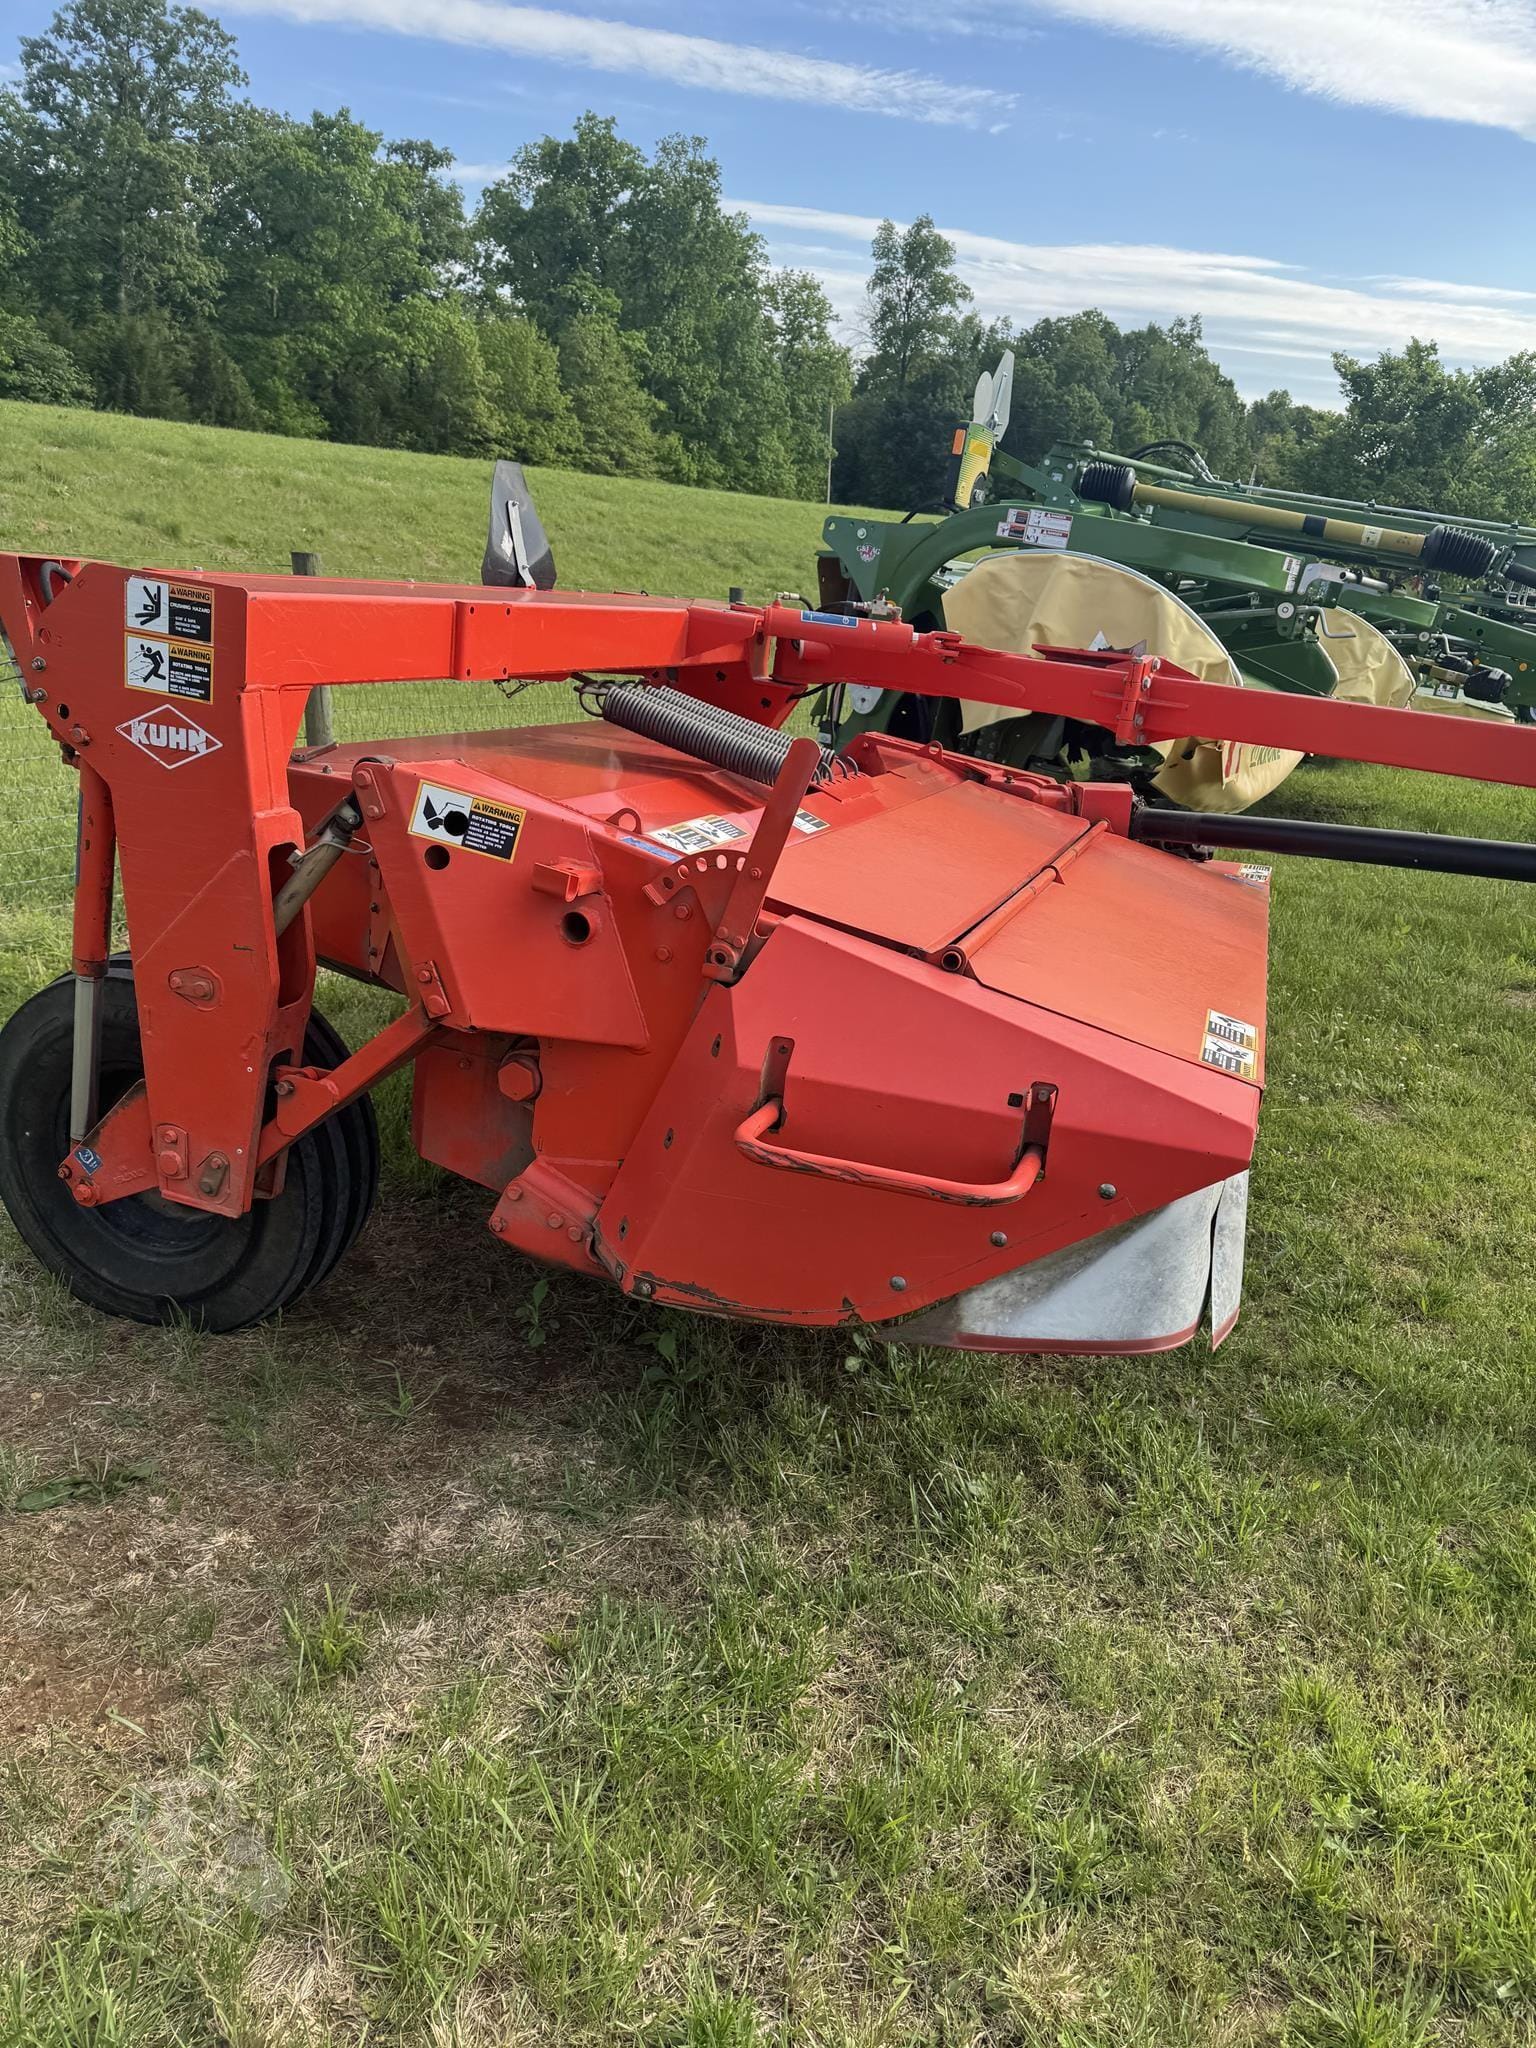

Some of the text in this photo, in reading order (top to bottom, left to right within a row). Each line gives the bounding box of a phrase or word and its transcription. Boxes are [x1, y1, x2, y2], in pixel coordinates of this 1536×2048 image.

[176, 588, 210, 601] WARNING
[170, 602, 210, 614] CRUSHING HAZARD
[177, 648, 210, 661] WARNING
[131, 719, 207, 754] KUHN
[481, 804, 520, 821] WARNING
[471, 815, 515, 831] ROTATING TOOLS
